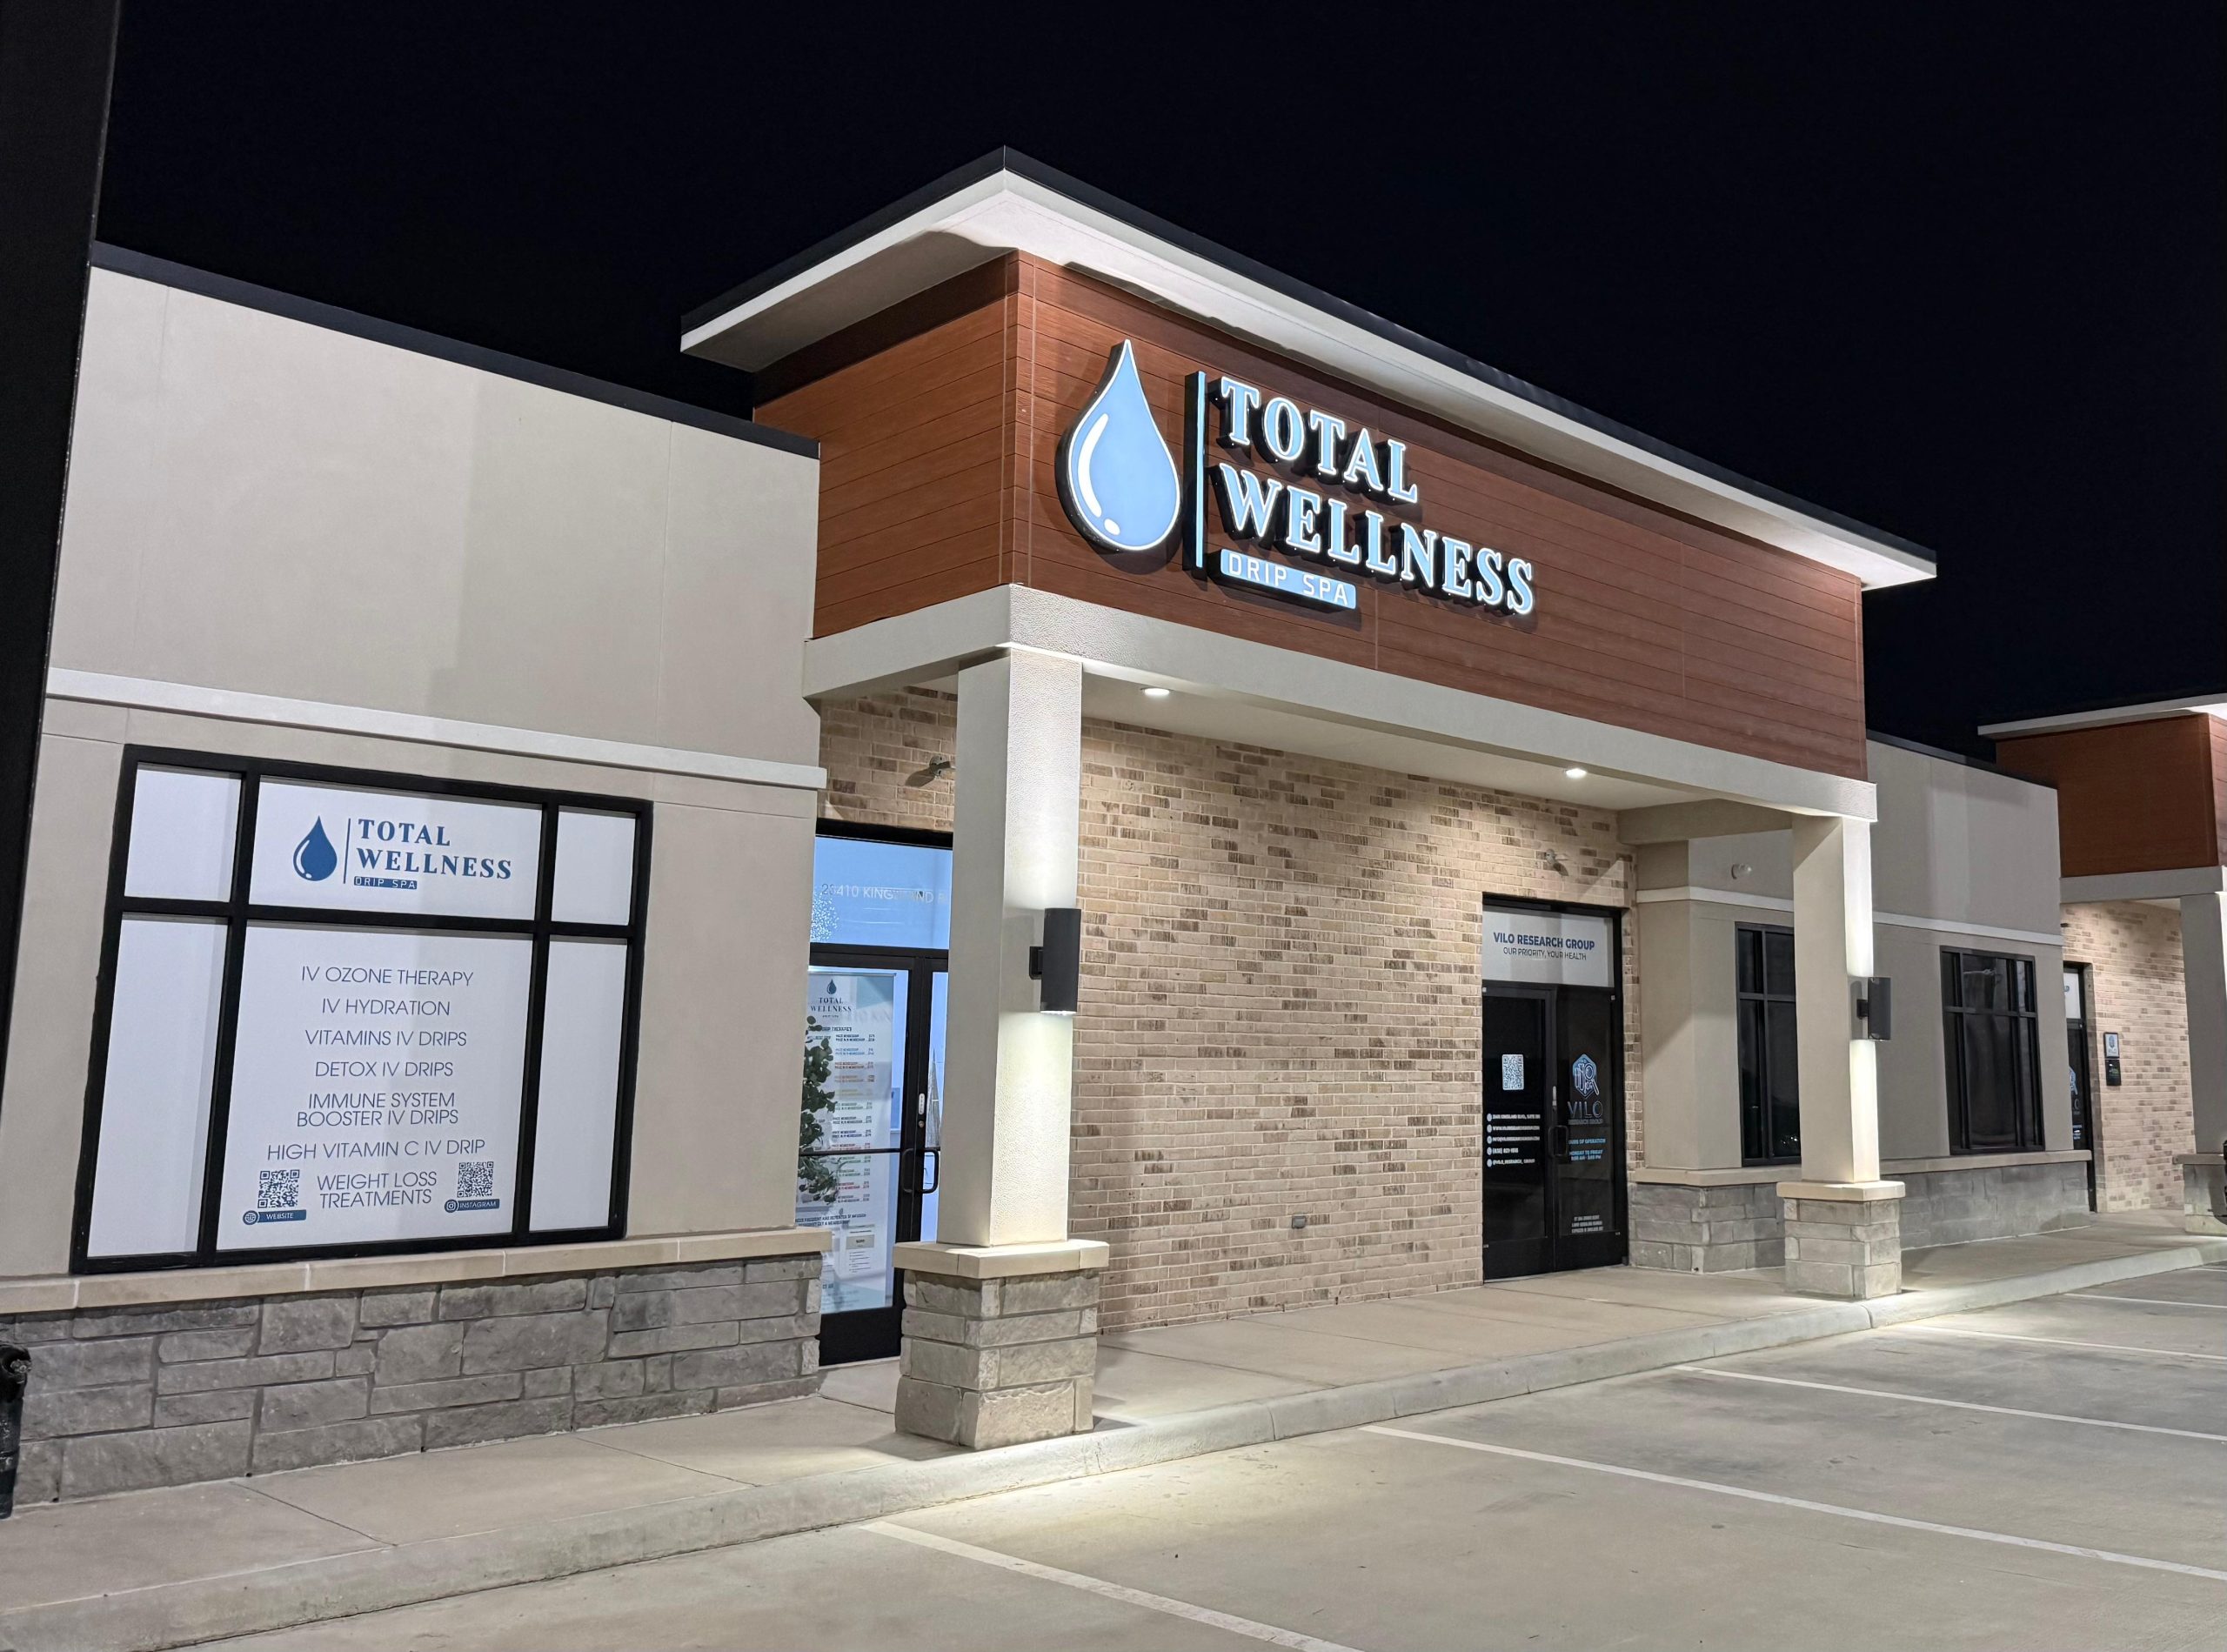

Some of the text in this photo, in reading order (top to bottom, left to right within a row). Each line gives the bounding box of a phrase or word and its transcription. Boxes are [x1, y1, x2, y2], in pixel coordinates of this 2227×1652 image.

[1221, 377, 1417, 503] TOTAL
[1220, 463, 1534, 614] WELLNESS
[1228, 552, 1348, 605] DRIP SPA
[358, 819, 451, 846] TOTAL
[356, 847, 512, 880] WELLNESS
[355, 877, 416, 889] DRIP SPA
[1493, 932, 1595, 950] VILO RESEARCH GROUP
[1503, 946, 1587, 960] OUR PRIORITY, YOUR HEALTH
[302, 966, 474, 986] IV OZONE THERAPY
[322, 999, 451, 1015] IV HYDRATION
[811, 1004, 852, 1013] WELLNESS
[304, 1029, 467, 1047] VITAMINS IV DRIPS
[315, 1061, 453, 1077] DETOX IV DRIPS
[308, 1092, 455, 1109] IMMUNE SYSTEM
[1568, 1100, 1603, 1119] VILO
[297, 1109, 459, 1127] BOOSTER IV DRIPS
[267, 1139, 485, 1160] HIGH VITAMIN C IV DRIP
[317, 1171, 437, 1191] WEIGHT LOSS
[319, 1188, 432, 1209] TREATMENTS
[459, 1201, 497, 1209] INSTAGRAM
